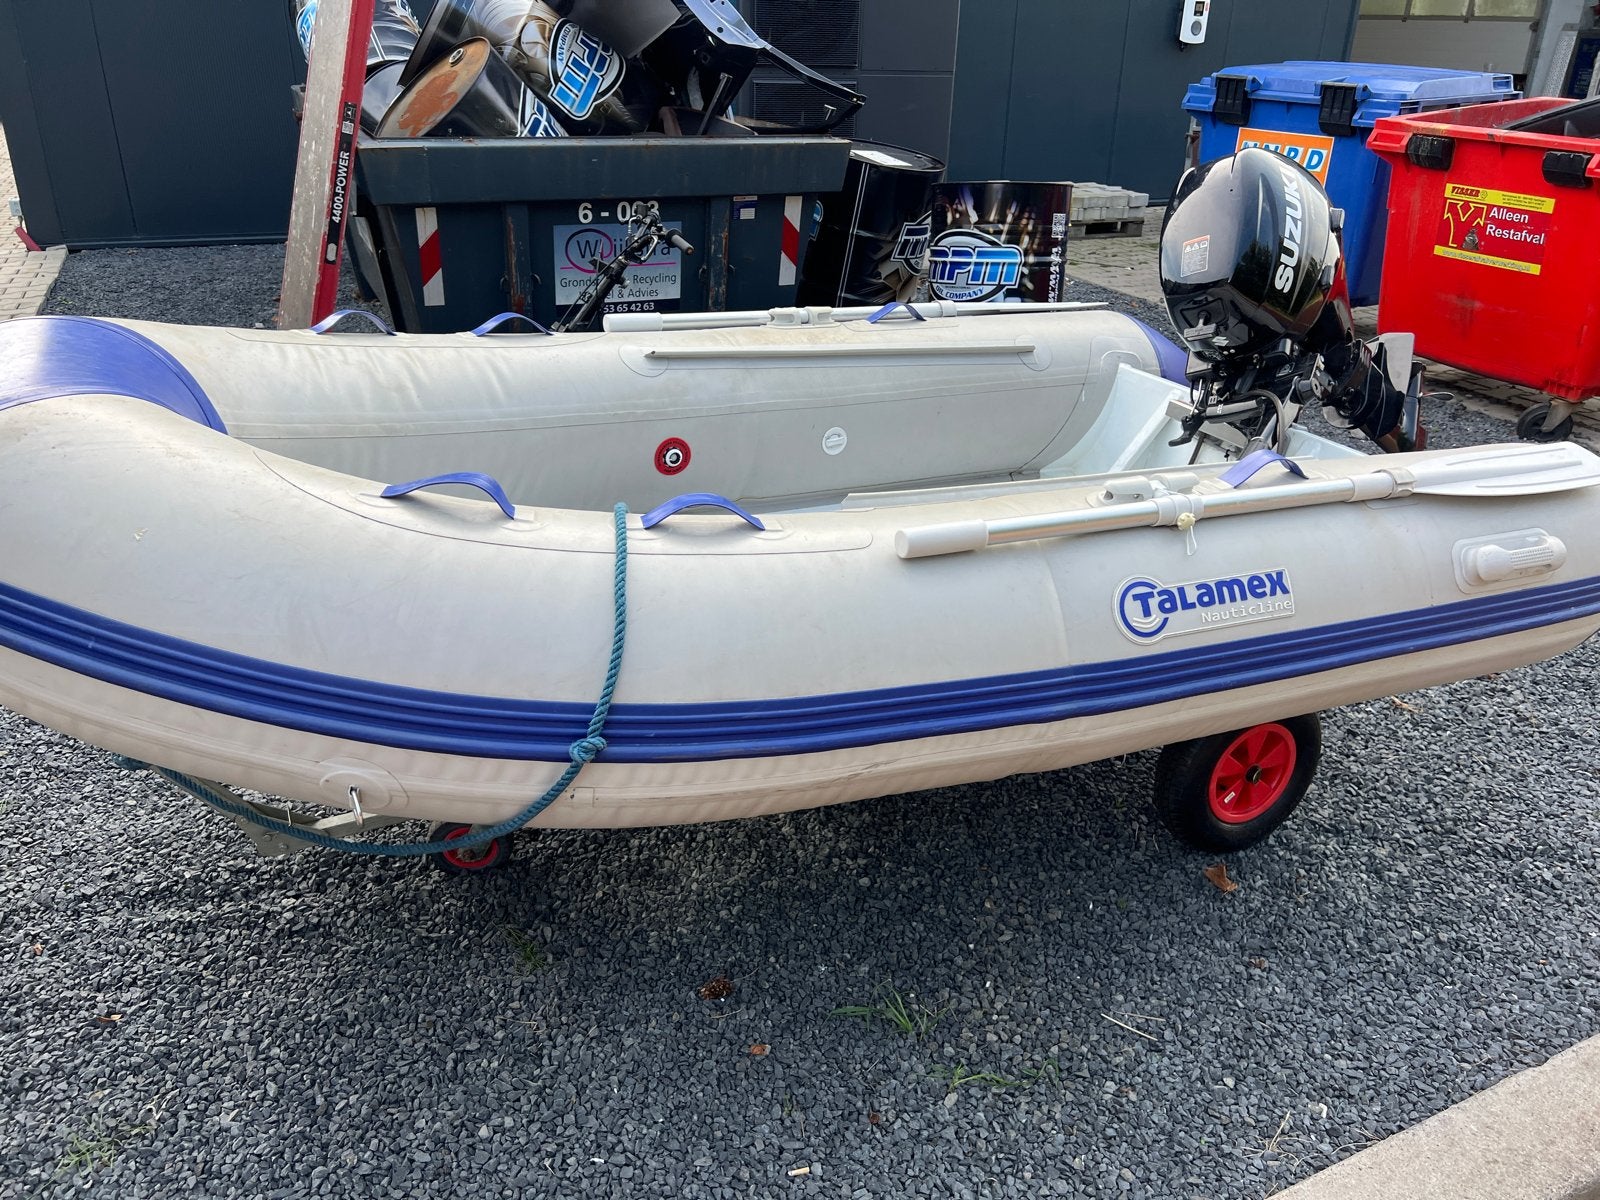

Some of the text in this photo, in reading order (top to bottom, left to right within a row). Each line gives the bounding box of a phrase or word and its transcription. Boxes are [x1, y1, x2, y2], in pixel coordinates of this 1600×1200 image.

[332, 150, 350, 225] 4400-POWER
[578, 202, 593, 224] 6
[1489, 206, 1529, 224] Alleen
[1274, 164, 1303, 294] SUZUKI
[1486, 224, 1545, 245] Restafval
[632, 272, 677, 286] Recycling
[617, 288, 624, 299] &
[627, 287, 659, 298] Advies
[945, 286, 984, 300] COMPANY
[616, 303, 629, 313] 65
[630, 302, 642, 312] 42
[643, 301, 655, 311] 63
[1201, 598, 1293, 624] Nauticline
